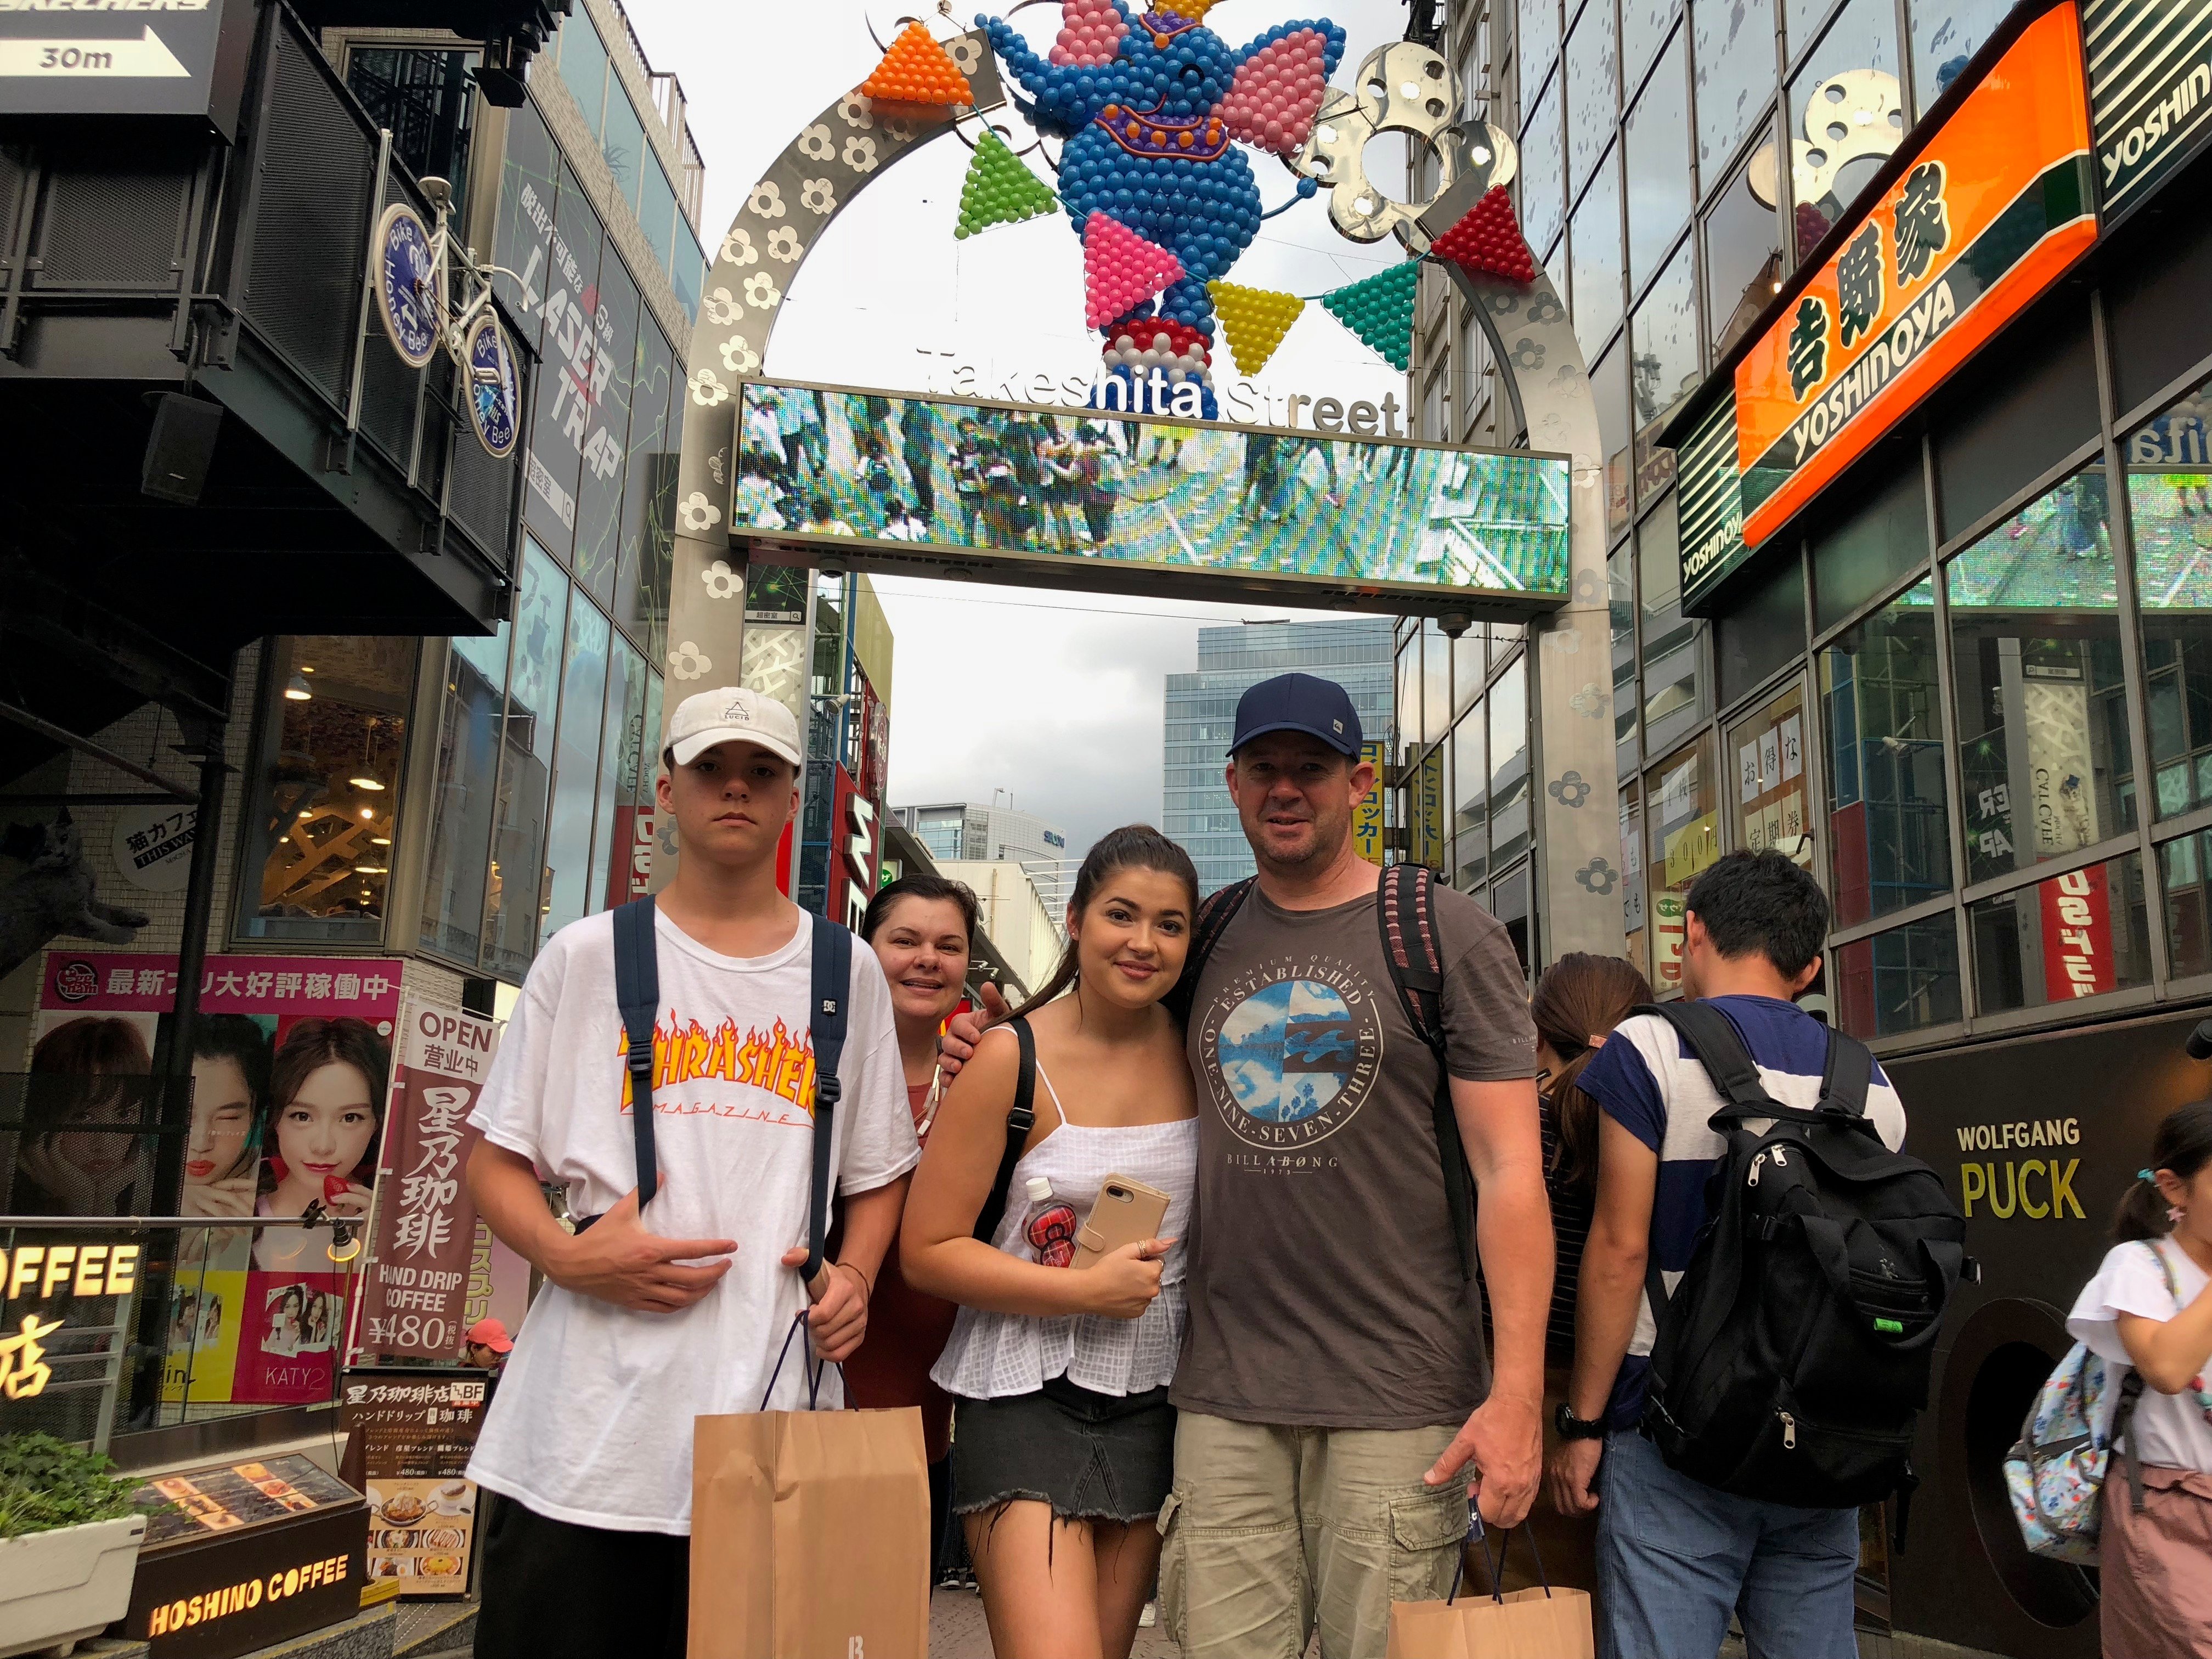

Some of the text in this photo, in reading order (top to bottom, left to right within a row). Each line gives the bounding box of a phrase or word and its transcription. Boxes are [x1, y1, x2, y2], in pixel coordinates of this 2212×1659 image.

[38, 47, 113, 70] 30m
[2102, 61, 2212, 188] YOSHIN
[390, 225, 413, 251] Bike
[1786, 160, 1951, 403] 吉野家
[408, 332, 427, 352] Bee
[477, 332, 498, 358] Bike
[522, 245, 614, 407] LASER
[1793, 279, 1956, 467] YOSHINOYA
[551, 366, 622, 481] TRAP
[1228, 379, 1405, 437] Street
[492, 425, 511, 444] Bee
[1745, 736, 1798, 785] お得な
[1356, 744, 1380, 854] コロッカー
[125, 810, 197, 854] 猫カフェ
[1044, 830, 1065, 848] SECOM
[138, 843, 171, 865] THIS
[1214, 955, 1376, 1003] PREMIUM QUALITY
[1220, 965, 1362, 1012] ESTABLISHED
[419, 1011, 493, 1052] OPEN
[424, 1044, 478, 1077] 营业中
[617, 1008, 817, 1120] THRASHER
[653, 1102, 790, 1124] MAGAZINE
[1957, 1118, 2080, 1152] WOLFGANG
[393, 1087, 471, 1260] 星乃珈琲
[1961, 1159, 2086, 1219] PUCK
[0, 1245, 140, 1299] FFEE
[379, 1265, 462, 1289] HAND DRIP
[386, 1290, 446, 1312] COFFEE
[369, 1315, 445, 1350] ¥480
[347, 1384, 451, 1406] 星乃珈琲店
[352, 1409, 426, 1422] ハンドドリップ
[439, 1408, 473, 1424] 珈琲
[149, 1554, 349, 1638] HOSHINO COFFEE
